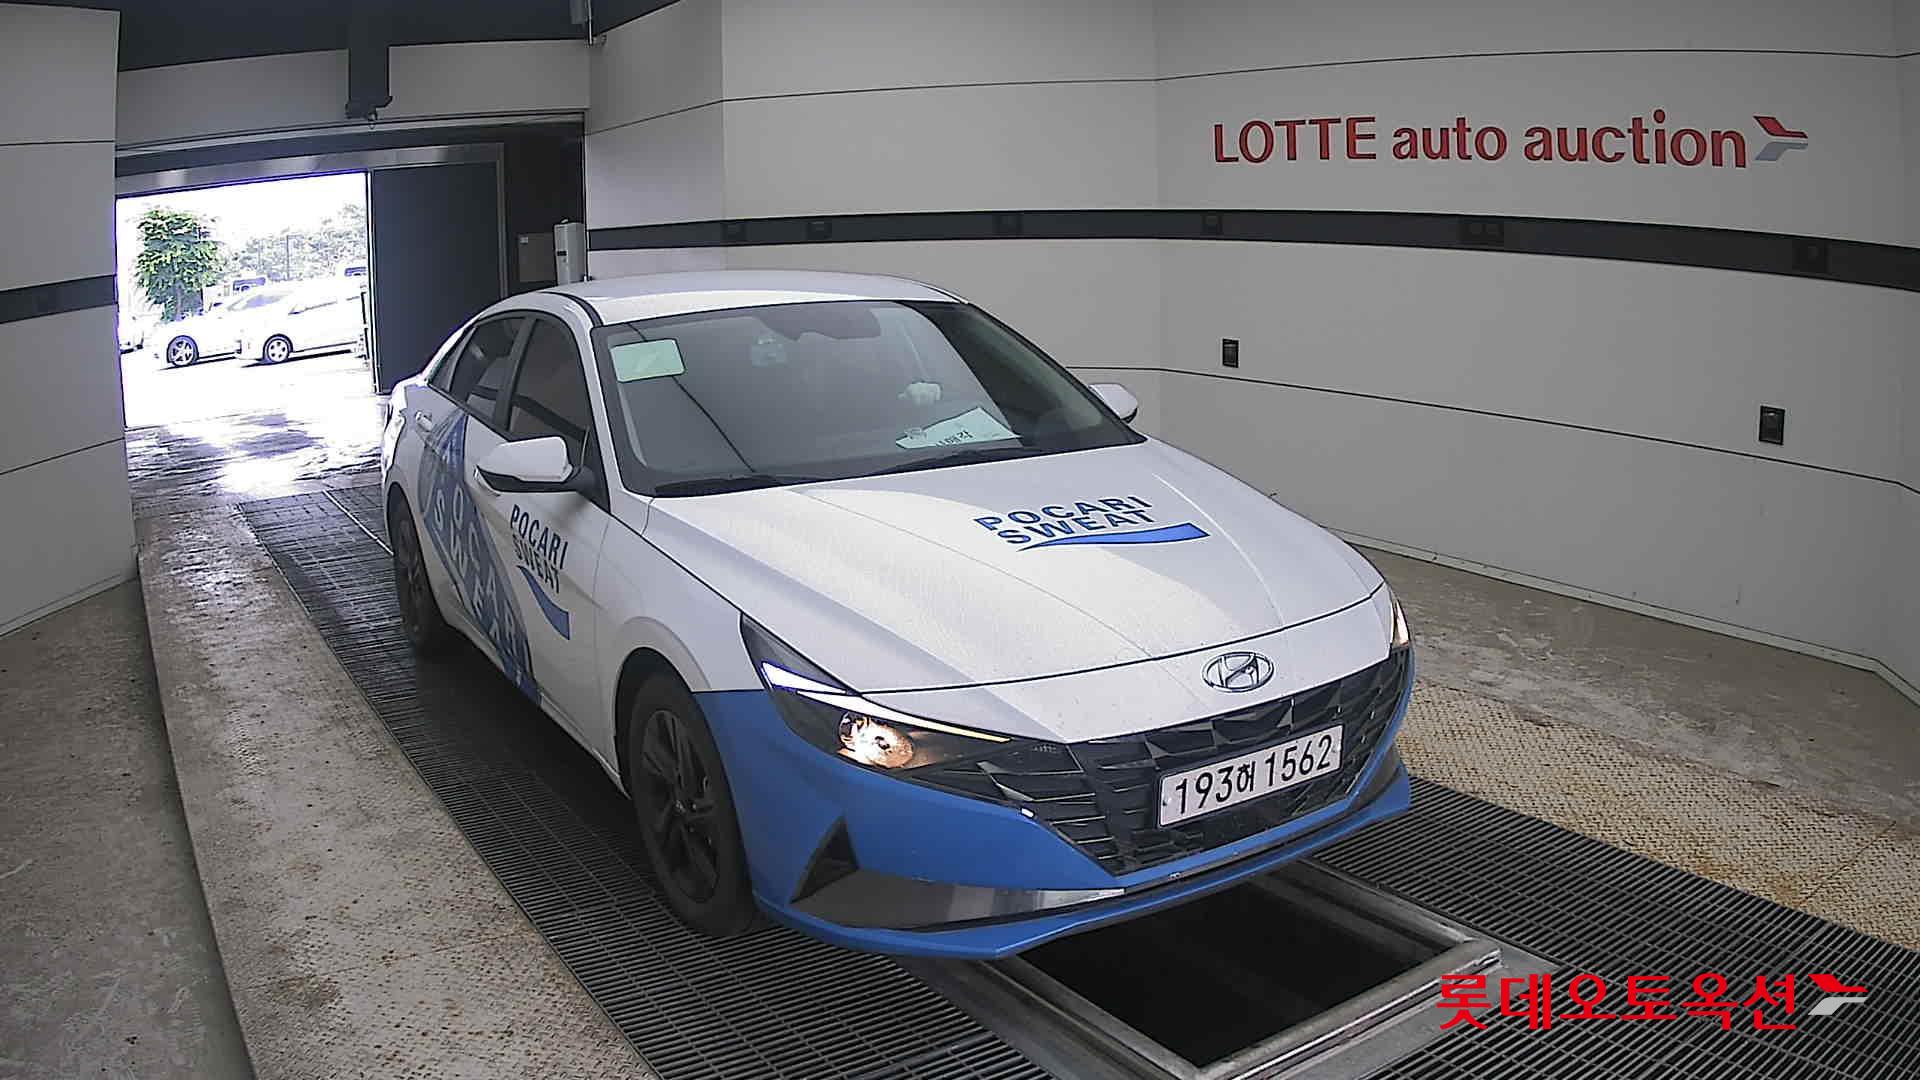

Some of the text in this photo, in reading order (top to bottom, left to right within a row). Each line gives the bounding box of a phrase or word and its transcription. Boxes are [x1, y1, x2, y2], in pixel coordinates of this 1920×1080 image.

[1213, 108, 1748, 169] LOTTE auto auction
[510, 503, 569, 570] POCARI
[974, 495, 1153, 531] POCARI
[998, 509, 1155, 544] SWEAT
[512, 533, 560, 594] SWEAT
[1175, 734, 1333, 814] 193허 1562
